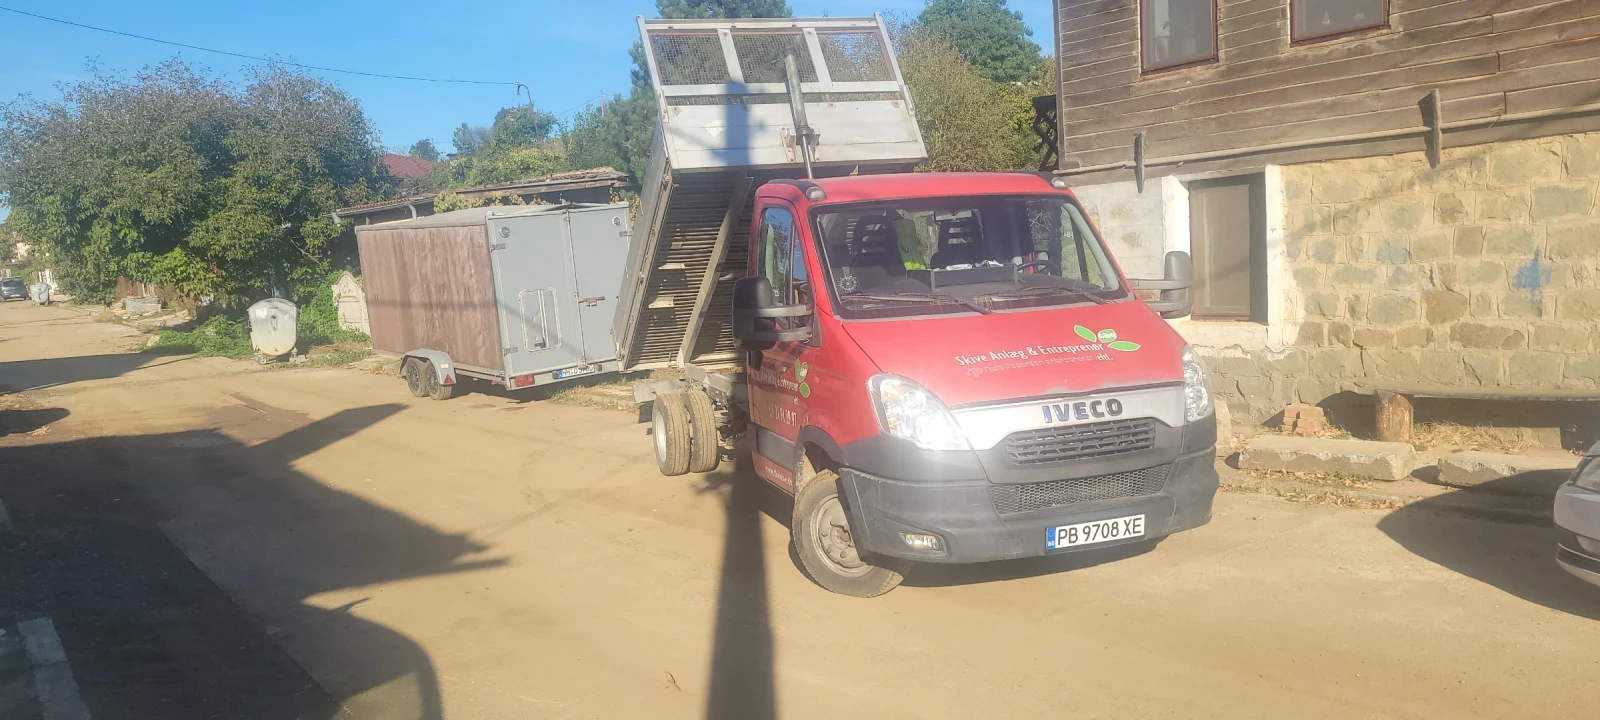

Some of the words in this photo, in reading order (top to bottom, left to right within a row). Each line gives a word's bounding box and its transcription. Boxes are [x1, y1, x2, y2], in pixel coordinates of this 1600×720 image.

[955, 354, 988, 367] Skive
[990, 349, 1027, 362] Anlæg
[1028, 347, 1037, 357] &
[1040, 341, 1104, 356] Entreprenør
[1041, 398, 1123, 424] IVECO
[1057, 527, 1078, 546] PB
[1082, 521, 1120, 542] 9708
[1123, 517, 1143, 536] XE
